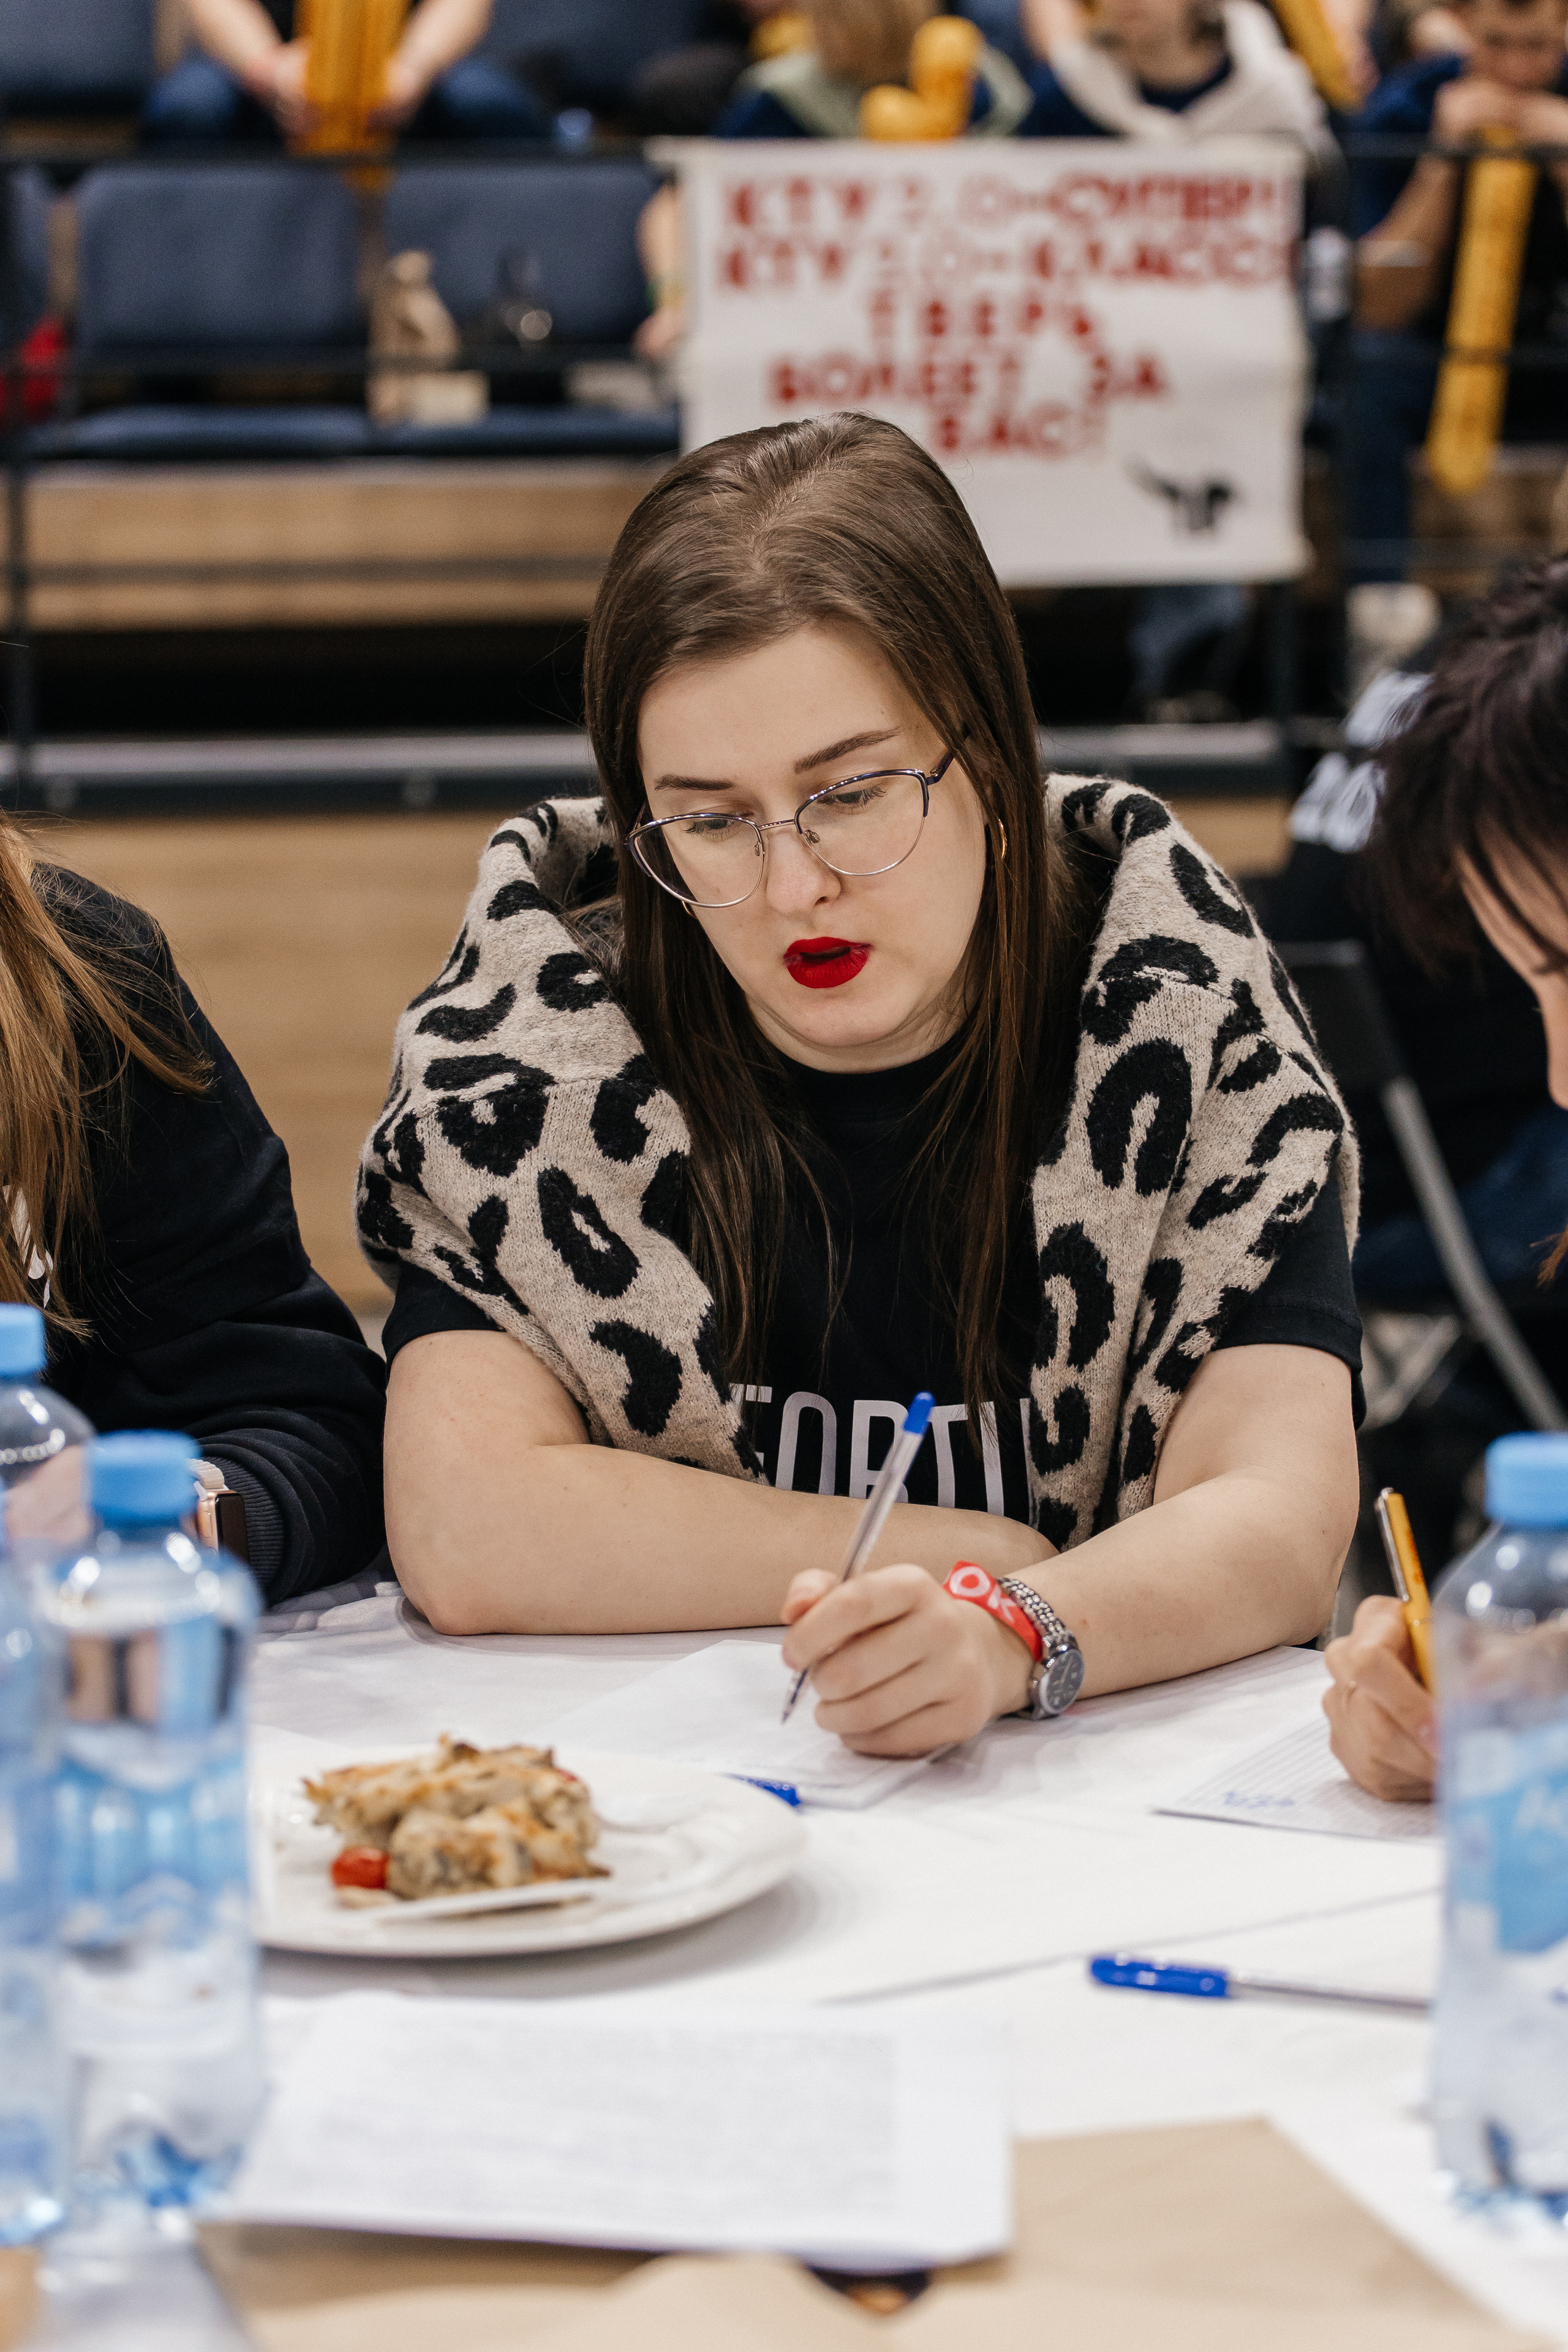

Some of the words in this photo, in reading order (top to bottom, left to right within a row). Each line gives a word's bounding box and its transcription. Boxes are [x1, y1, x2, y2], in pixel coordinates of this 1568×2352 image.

[865, 289, 1106, 350] ТВЕРЬ
[768, 349, 1029, 412] БОЛЕЕТ
[1079, 344, 1175, 405] ЗА
